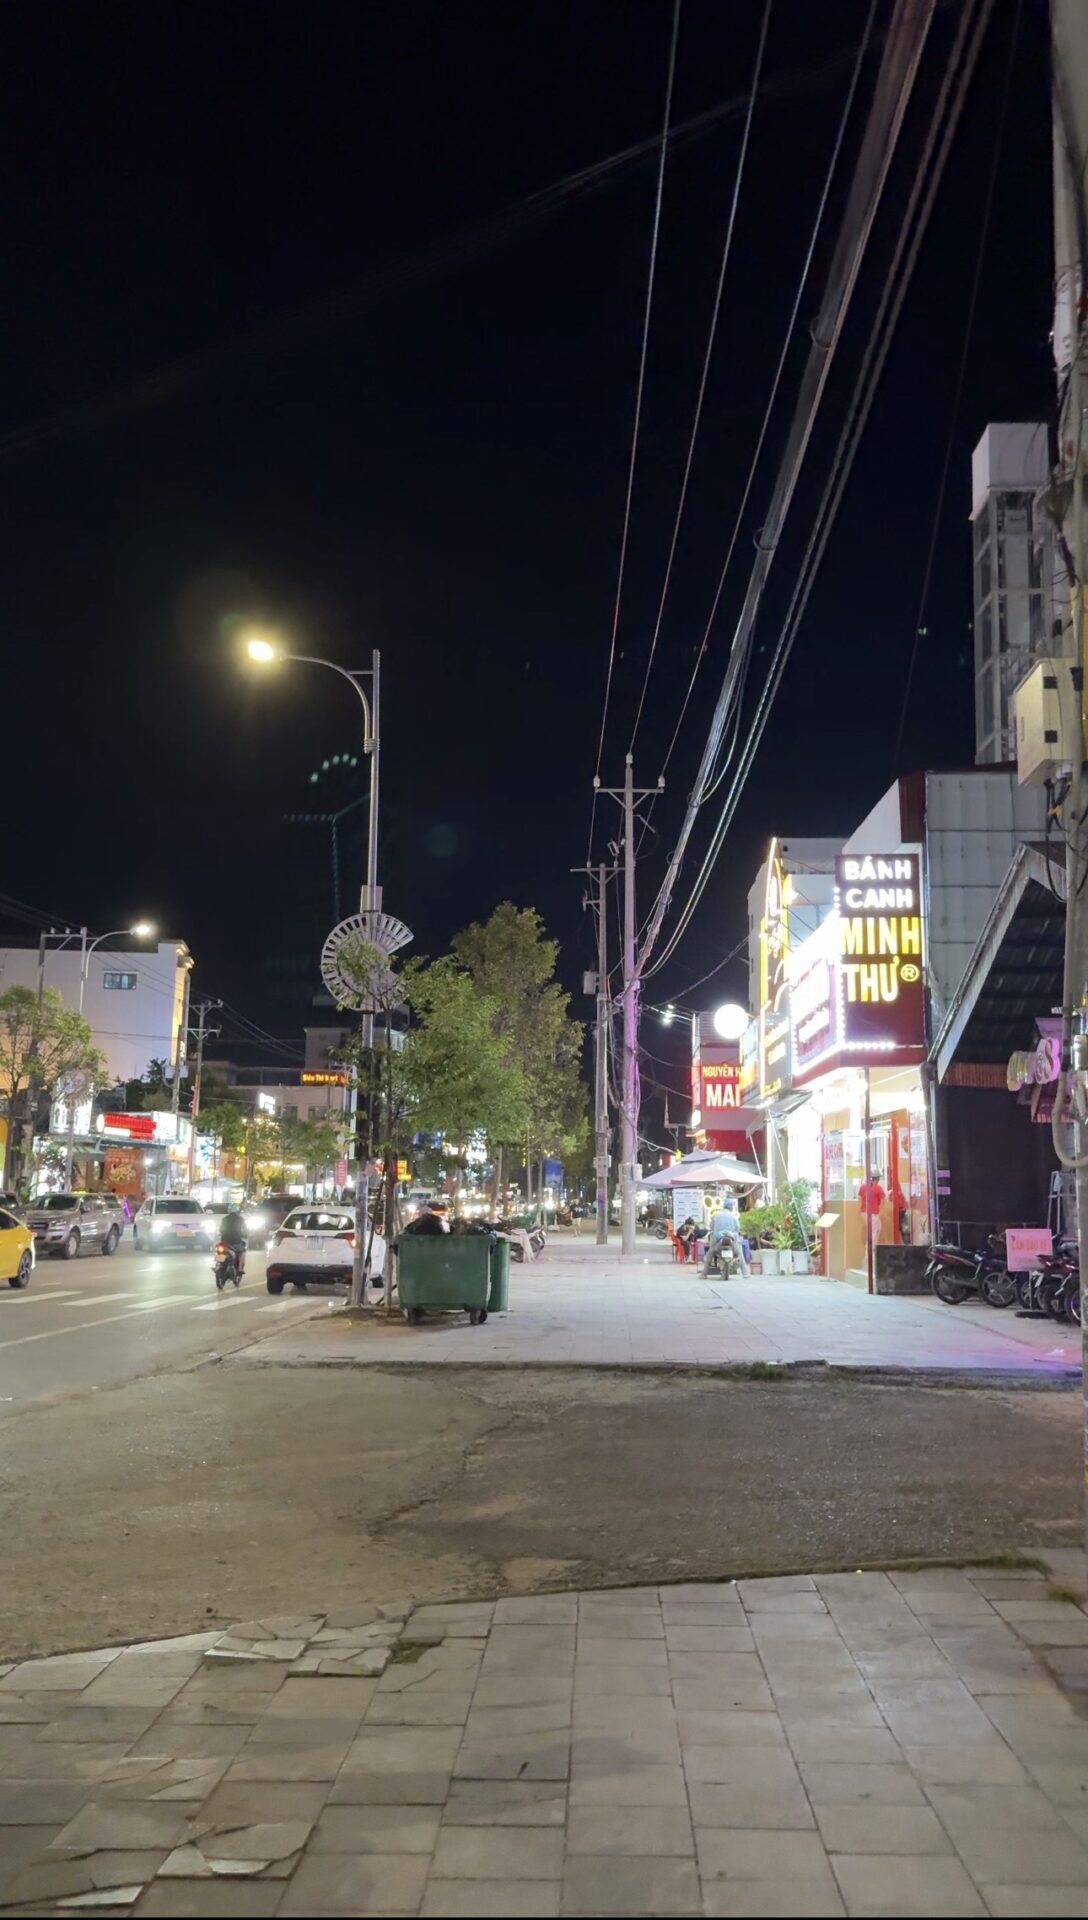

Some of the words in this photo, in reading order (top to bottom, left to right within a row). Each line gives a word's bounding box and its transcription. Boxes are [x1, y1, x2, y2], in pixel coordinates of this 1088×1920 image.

[844, 856, 912, 880] BÁNH
[845, 888, 914, 908] CANH
[840, 916, 920, 955] MINH
